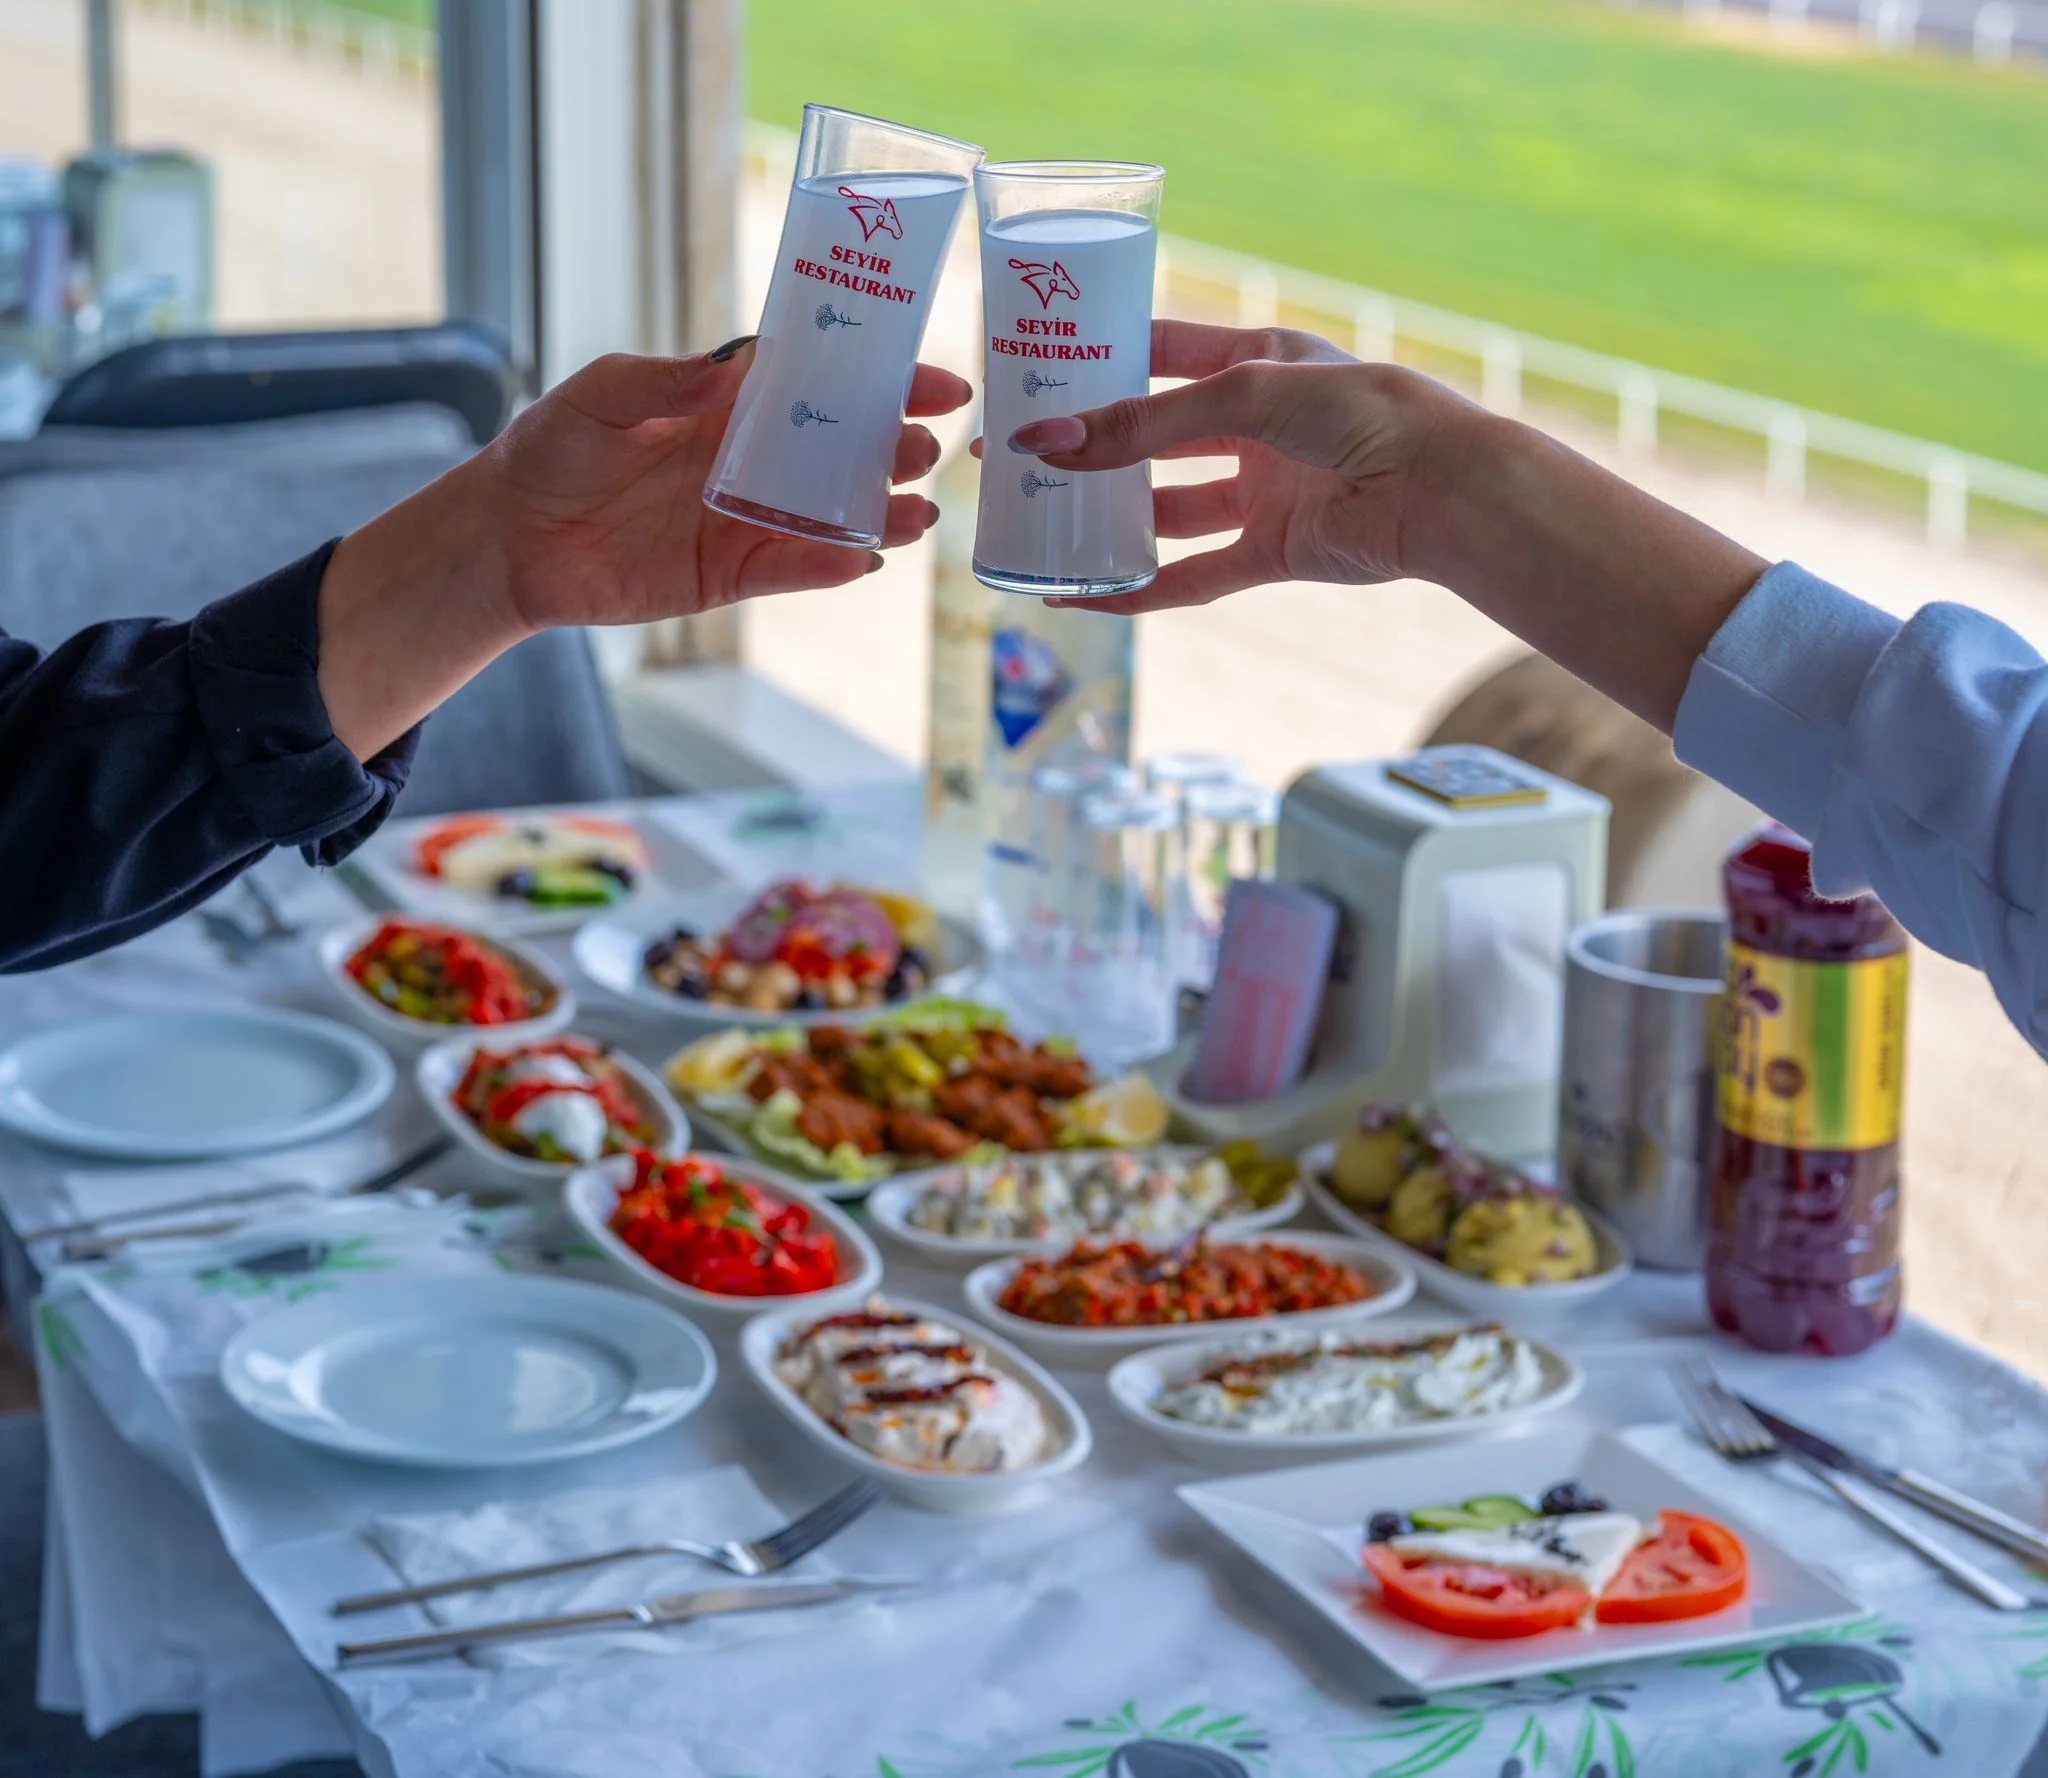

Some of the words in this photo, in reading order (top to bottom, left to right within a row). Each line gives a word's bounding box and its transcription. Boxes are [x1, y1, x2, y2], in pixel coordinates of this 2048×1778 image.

[830, 245, 892, 275] SEYİR
[794, 258, 916, 305] RESTAURANT
[1016, 317, 1077, 337] SEYİR
[992, 338, 1113, 361] RESTAURANT
